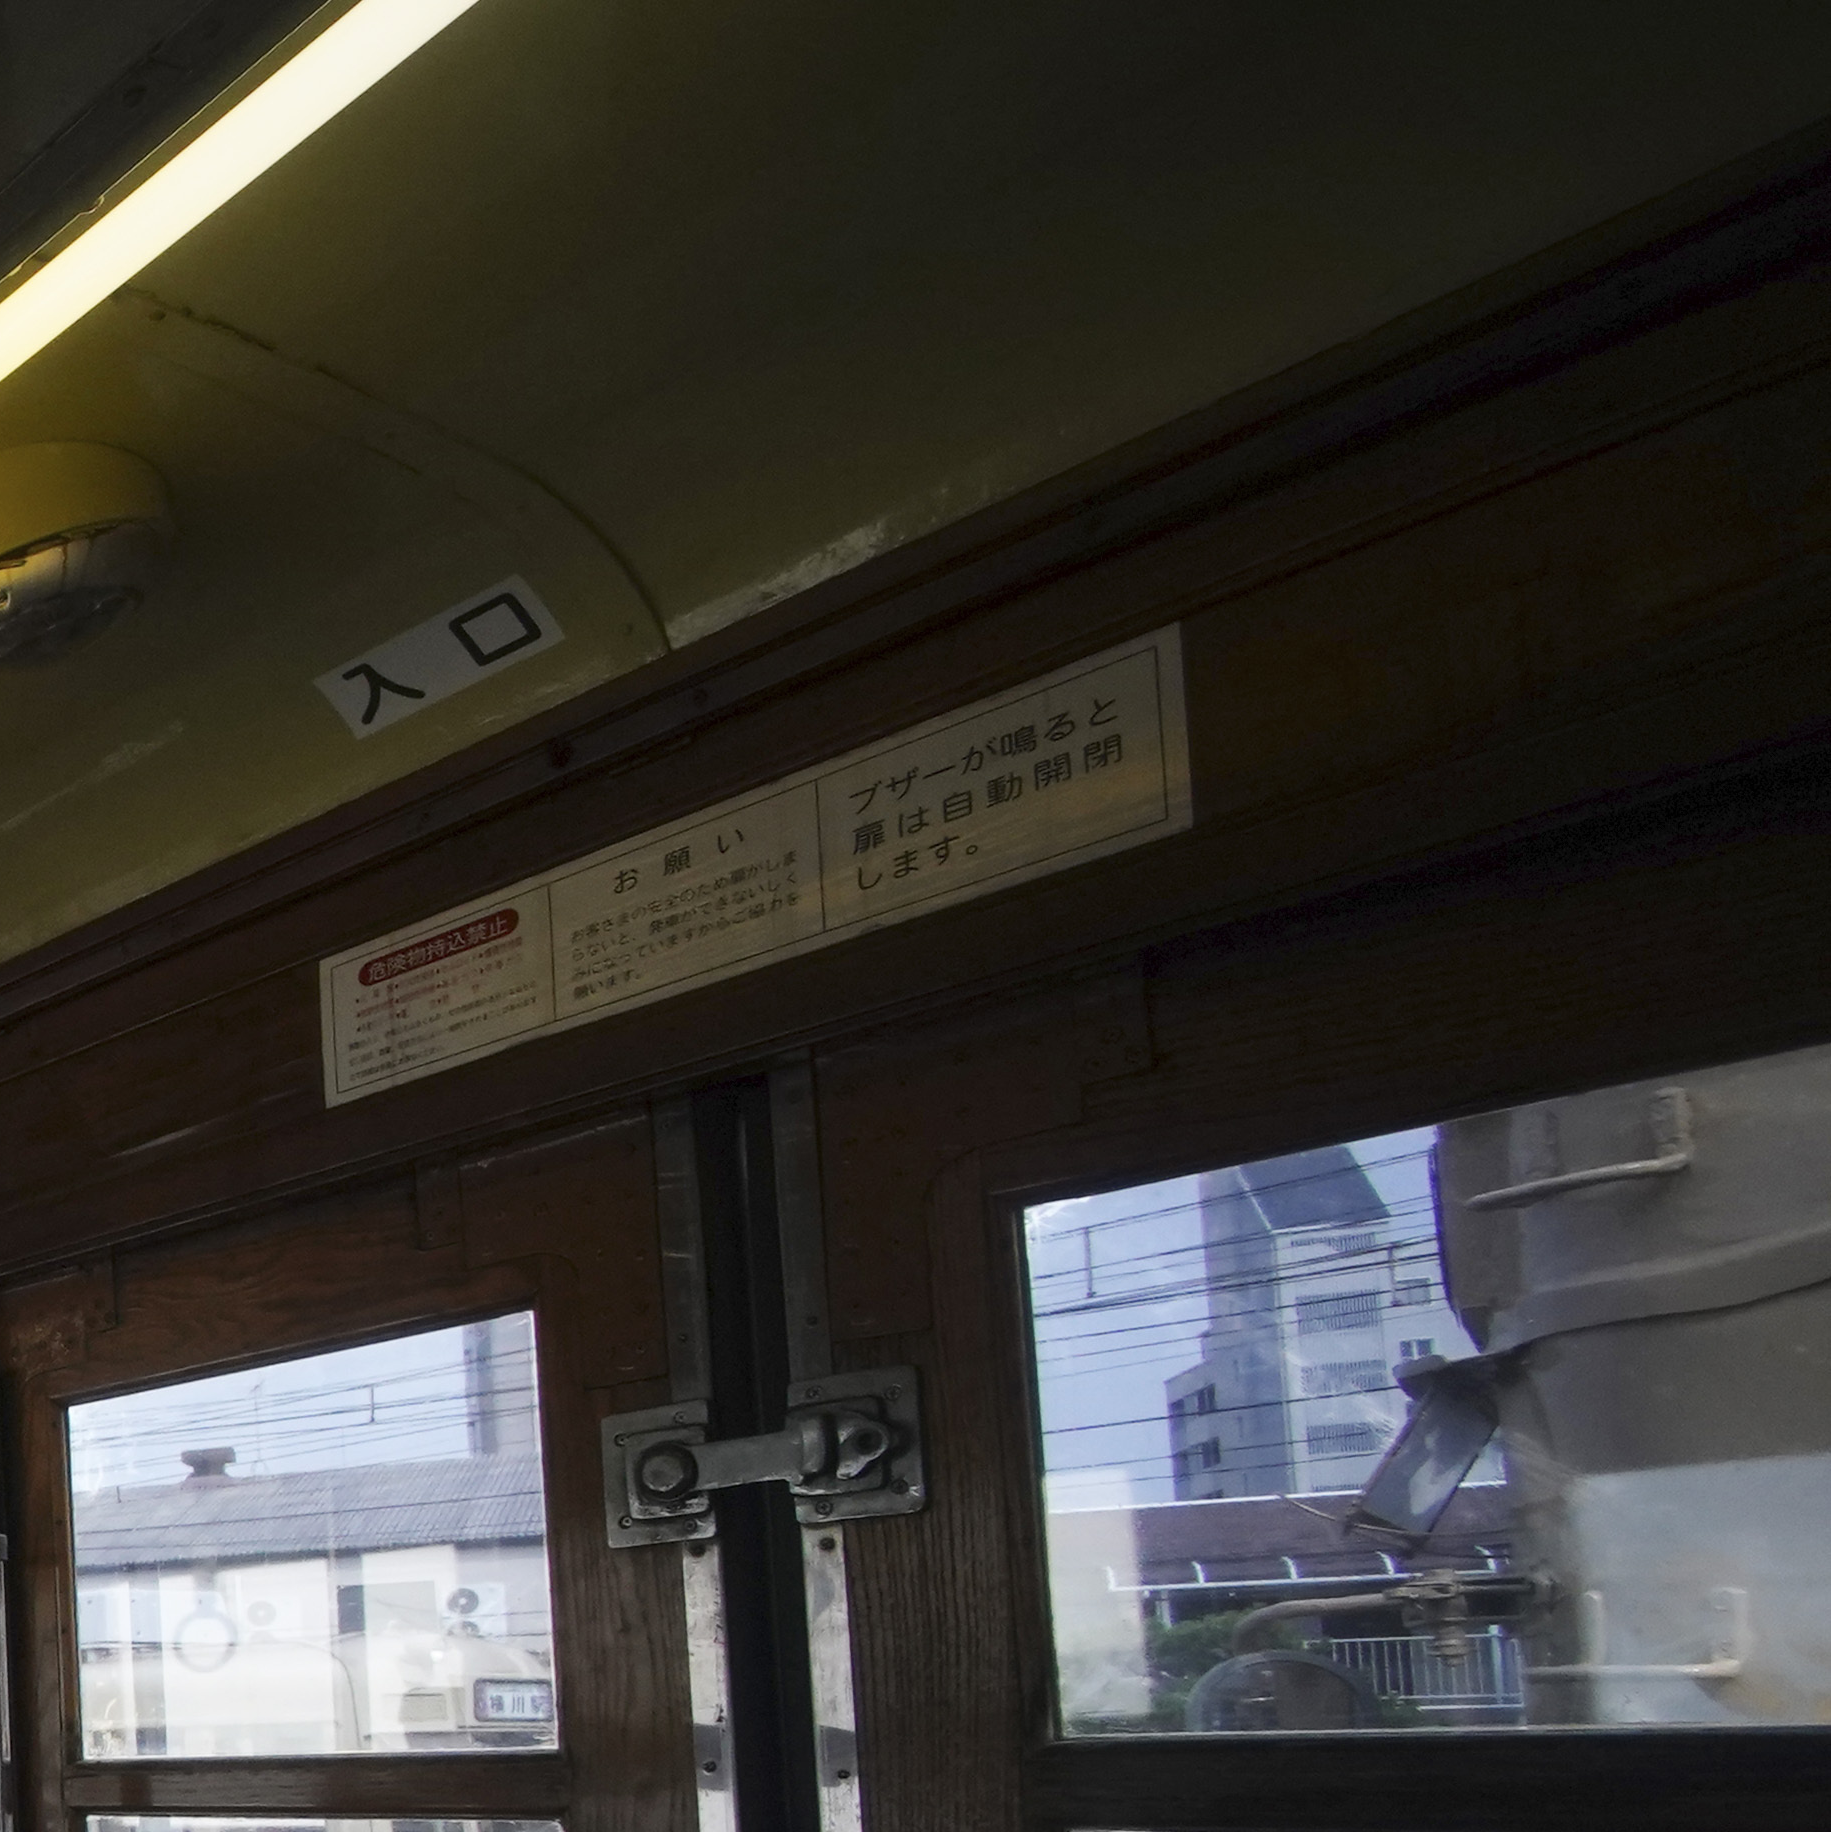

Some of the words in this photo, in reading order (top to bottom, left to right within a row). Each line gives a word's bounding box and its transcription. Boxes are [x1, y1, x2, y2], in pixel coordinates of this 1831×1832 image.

[341, 592, 543, 724] 入口
[848, 697, 1119, 815] ブザーが鳴ると
[852, 733, 1123, 855] 扉は自動開閉
[612, 828, 745, 894] お願い
[857, 834, 980, 891] します。
[367, 915, 508, 982] 危険物持込禁止
